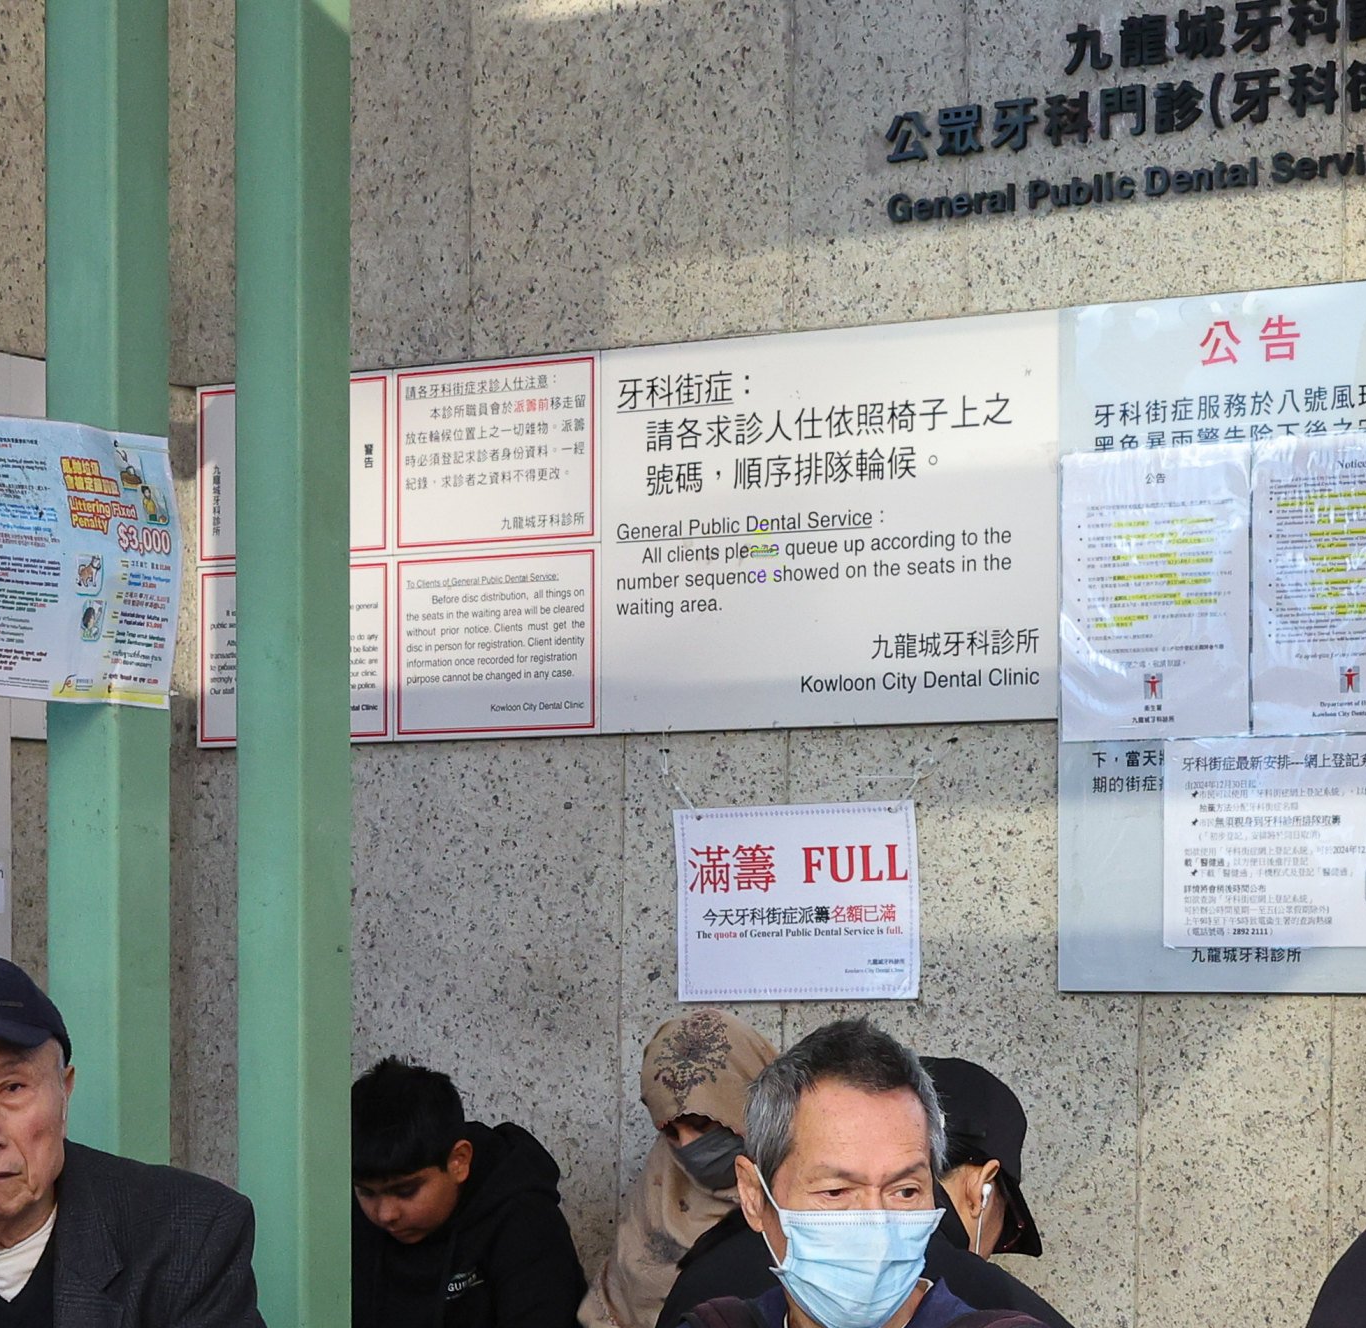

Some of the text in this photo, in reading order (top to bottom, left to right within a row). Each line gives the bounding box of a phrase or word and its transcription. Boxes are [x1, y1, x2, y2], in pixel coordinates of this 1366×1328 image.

[887, 183, 1019, 226] General
[1026, 171, 1137, 212] Public
[1143, 154, 1259, 197] Dental
[1199, 313, 1302, 367] 公告
[616, 370, 752, 413] 牙科街症：
[645, 391, 1013, 453] 請各求診人仕依照椅子上之
[645, 445, 939, 497] 號碼，順序排隊輪候。
[68, 496, 138, 520] Littering Fixed
[72, 512, 110, 535] Penalty
[501, 512, 585, 531] 九龍城牙科診所
[617, 509, 872, 540] General Public Dental Service
[117, 522, 172, 556] $3,000
[642, 547, 661, 564] All
[667, 545, 719, 563] clients
[785, 540, 838, 560] queue
[844, 539, 865, 556] up
[871, 530, 955, 552] according
[961, 530, 978, 546] to
[984, 527, 1011, 544] the
[617, 554, 1011, 590] number sequence showed on the seats in the
[616, 598, 722, 618] waiting area.
[871, 627, 1040, 661] 九龍城牙科診所
[801, 667, 1039, 693] Kowloon City Dental Clinic
[490, 700, 584, 712] Kowloon City Dental Clinic
[688, 843, 909, 894] 滿籌 FULL
[702, 903, 897, 927] 今天牙科街症派籌名額已滿
[696, 926, 903, 940] The quota of General Public Dental Service is full.
